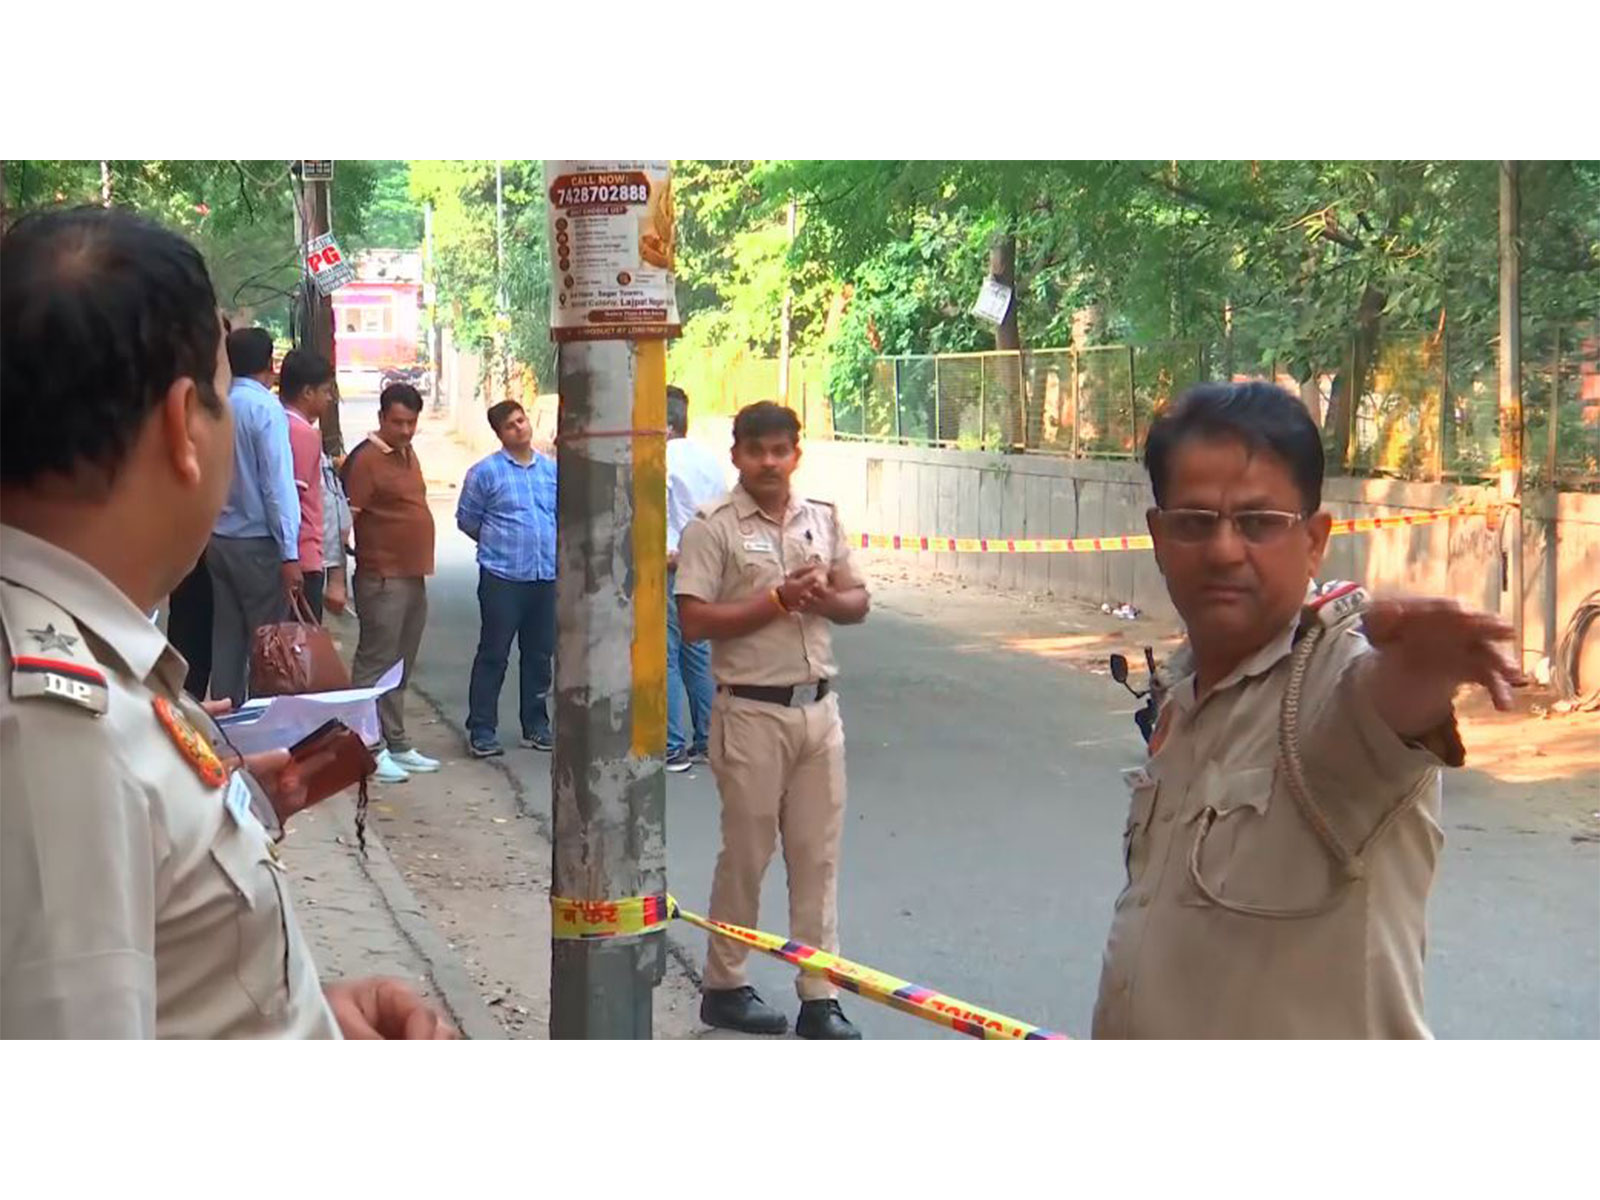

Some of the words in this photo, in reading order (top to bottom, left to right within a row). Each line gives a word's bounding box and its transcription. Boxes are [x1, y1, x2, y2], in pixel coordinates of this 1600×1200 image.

[571, 175, 595, 186] CALL
[557, 185, 647, 204] 7428702888
[307, 246, 341, 273] PG
